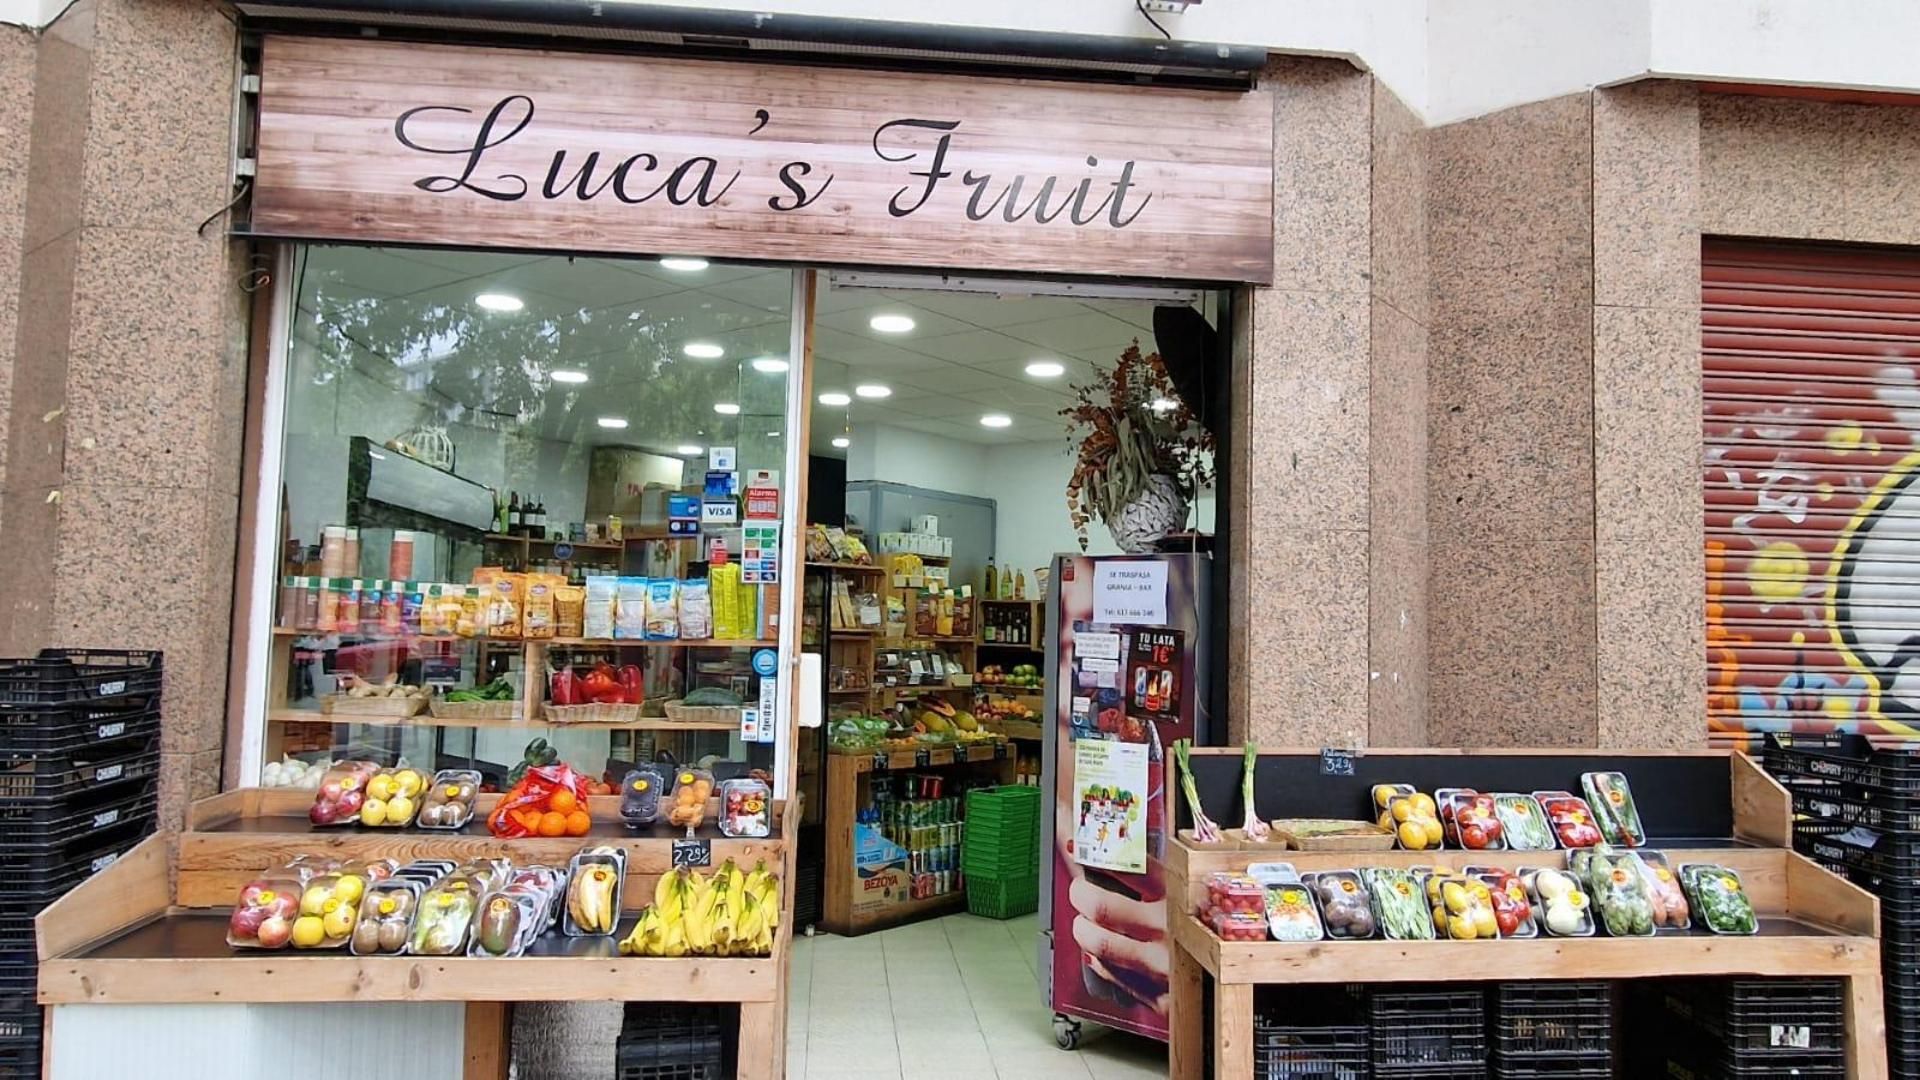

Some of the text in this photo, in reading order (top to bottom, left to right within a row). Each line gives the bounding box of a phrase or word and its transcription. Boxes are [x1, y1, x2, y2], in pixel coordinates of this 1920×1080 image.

[395, 95, 1153, 229] Luca's Fruit
[749, 489, 777, 497] Alarma
[708, 507, 732, 516] VISA
[1139, 632, 1175, 646] TU LATA
[863, 875, 898, 891] BEZOYA
